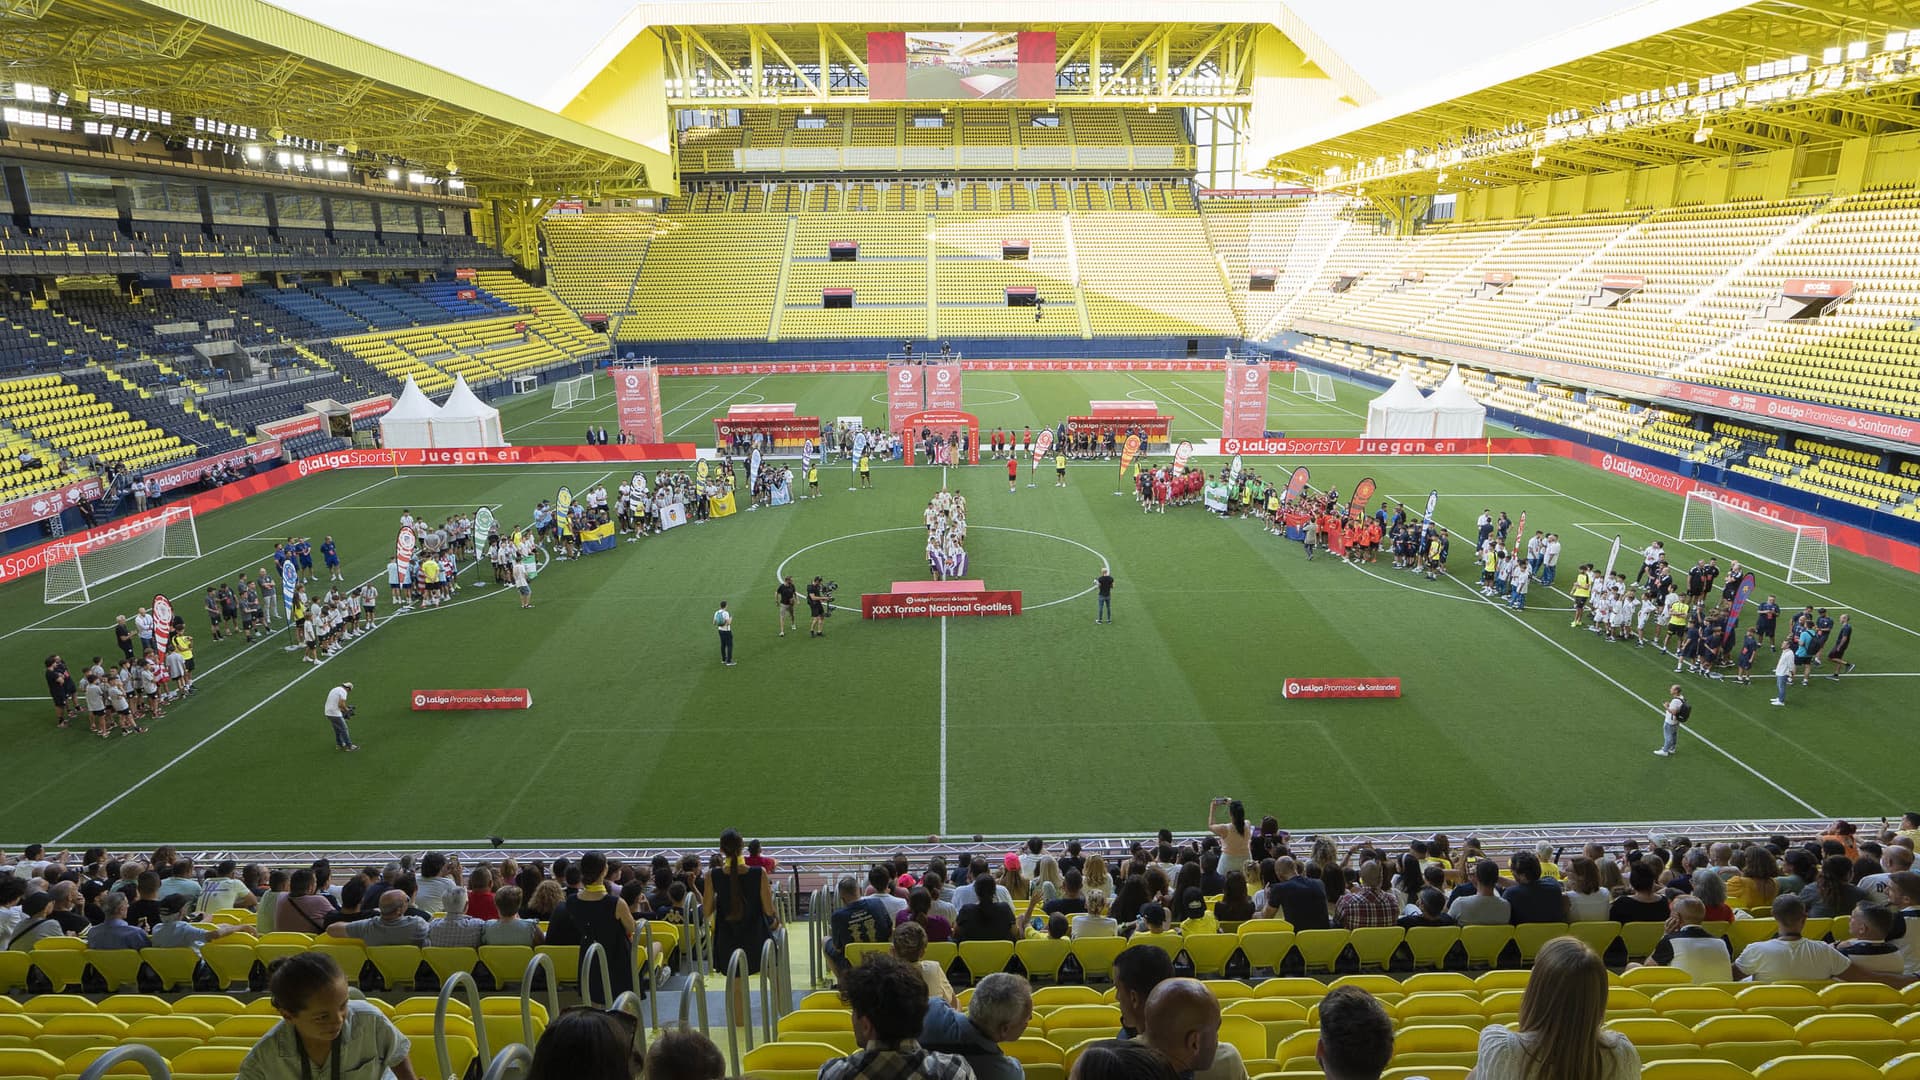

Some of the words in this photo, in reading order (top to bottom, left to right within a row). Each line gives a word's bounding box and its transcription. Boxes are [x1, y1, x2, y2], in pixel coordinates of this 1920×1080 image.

[1778, 404, 1804, 418] LaLiga
[1805, 408, 1848, 425] Promises
[1857, 417, 1913, 438] Santander
[1356, 440, 1425, 455] Juegan
[1434, 441, 1456, 452] en
[420, 449, 488, 464] Juegan
[498, 450, 519, 461] en
[872, 605, 891, 614] XXX
[894, 604, 926, 614] Torneo
[929, 603, 971, 613] Nacional
[974, 602, 1012, 612] Geotiles
[1365, 683, 1397, 691] Santander
[426, 696, 449, 704] LaLiga
[491, 695, 522, 703] Santander
